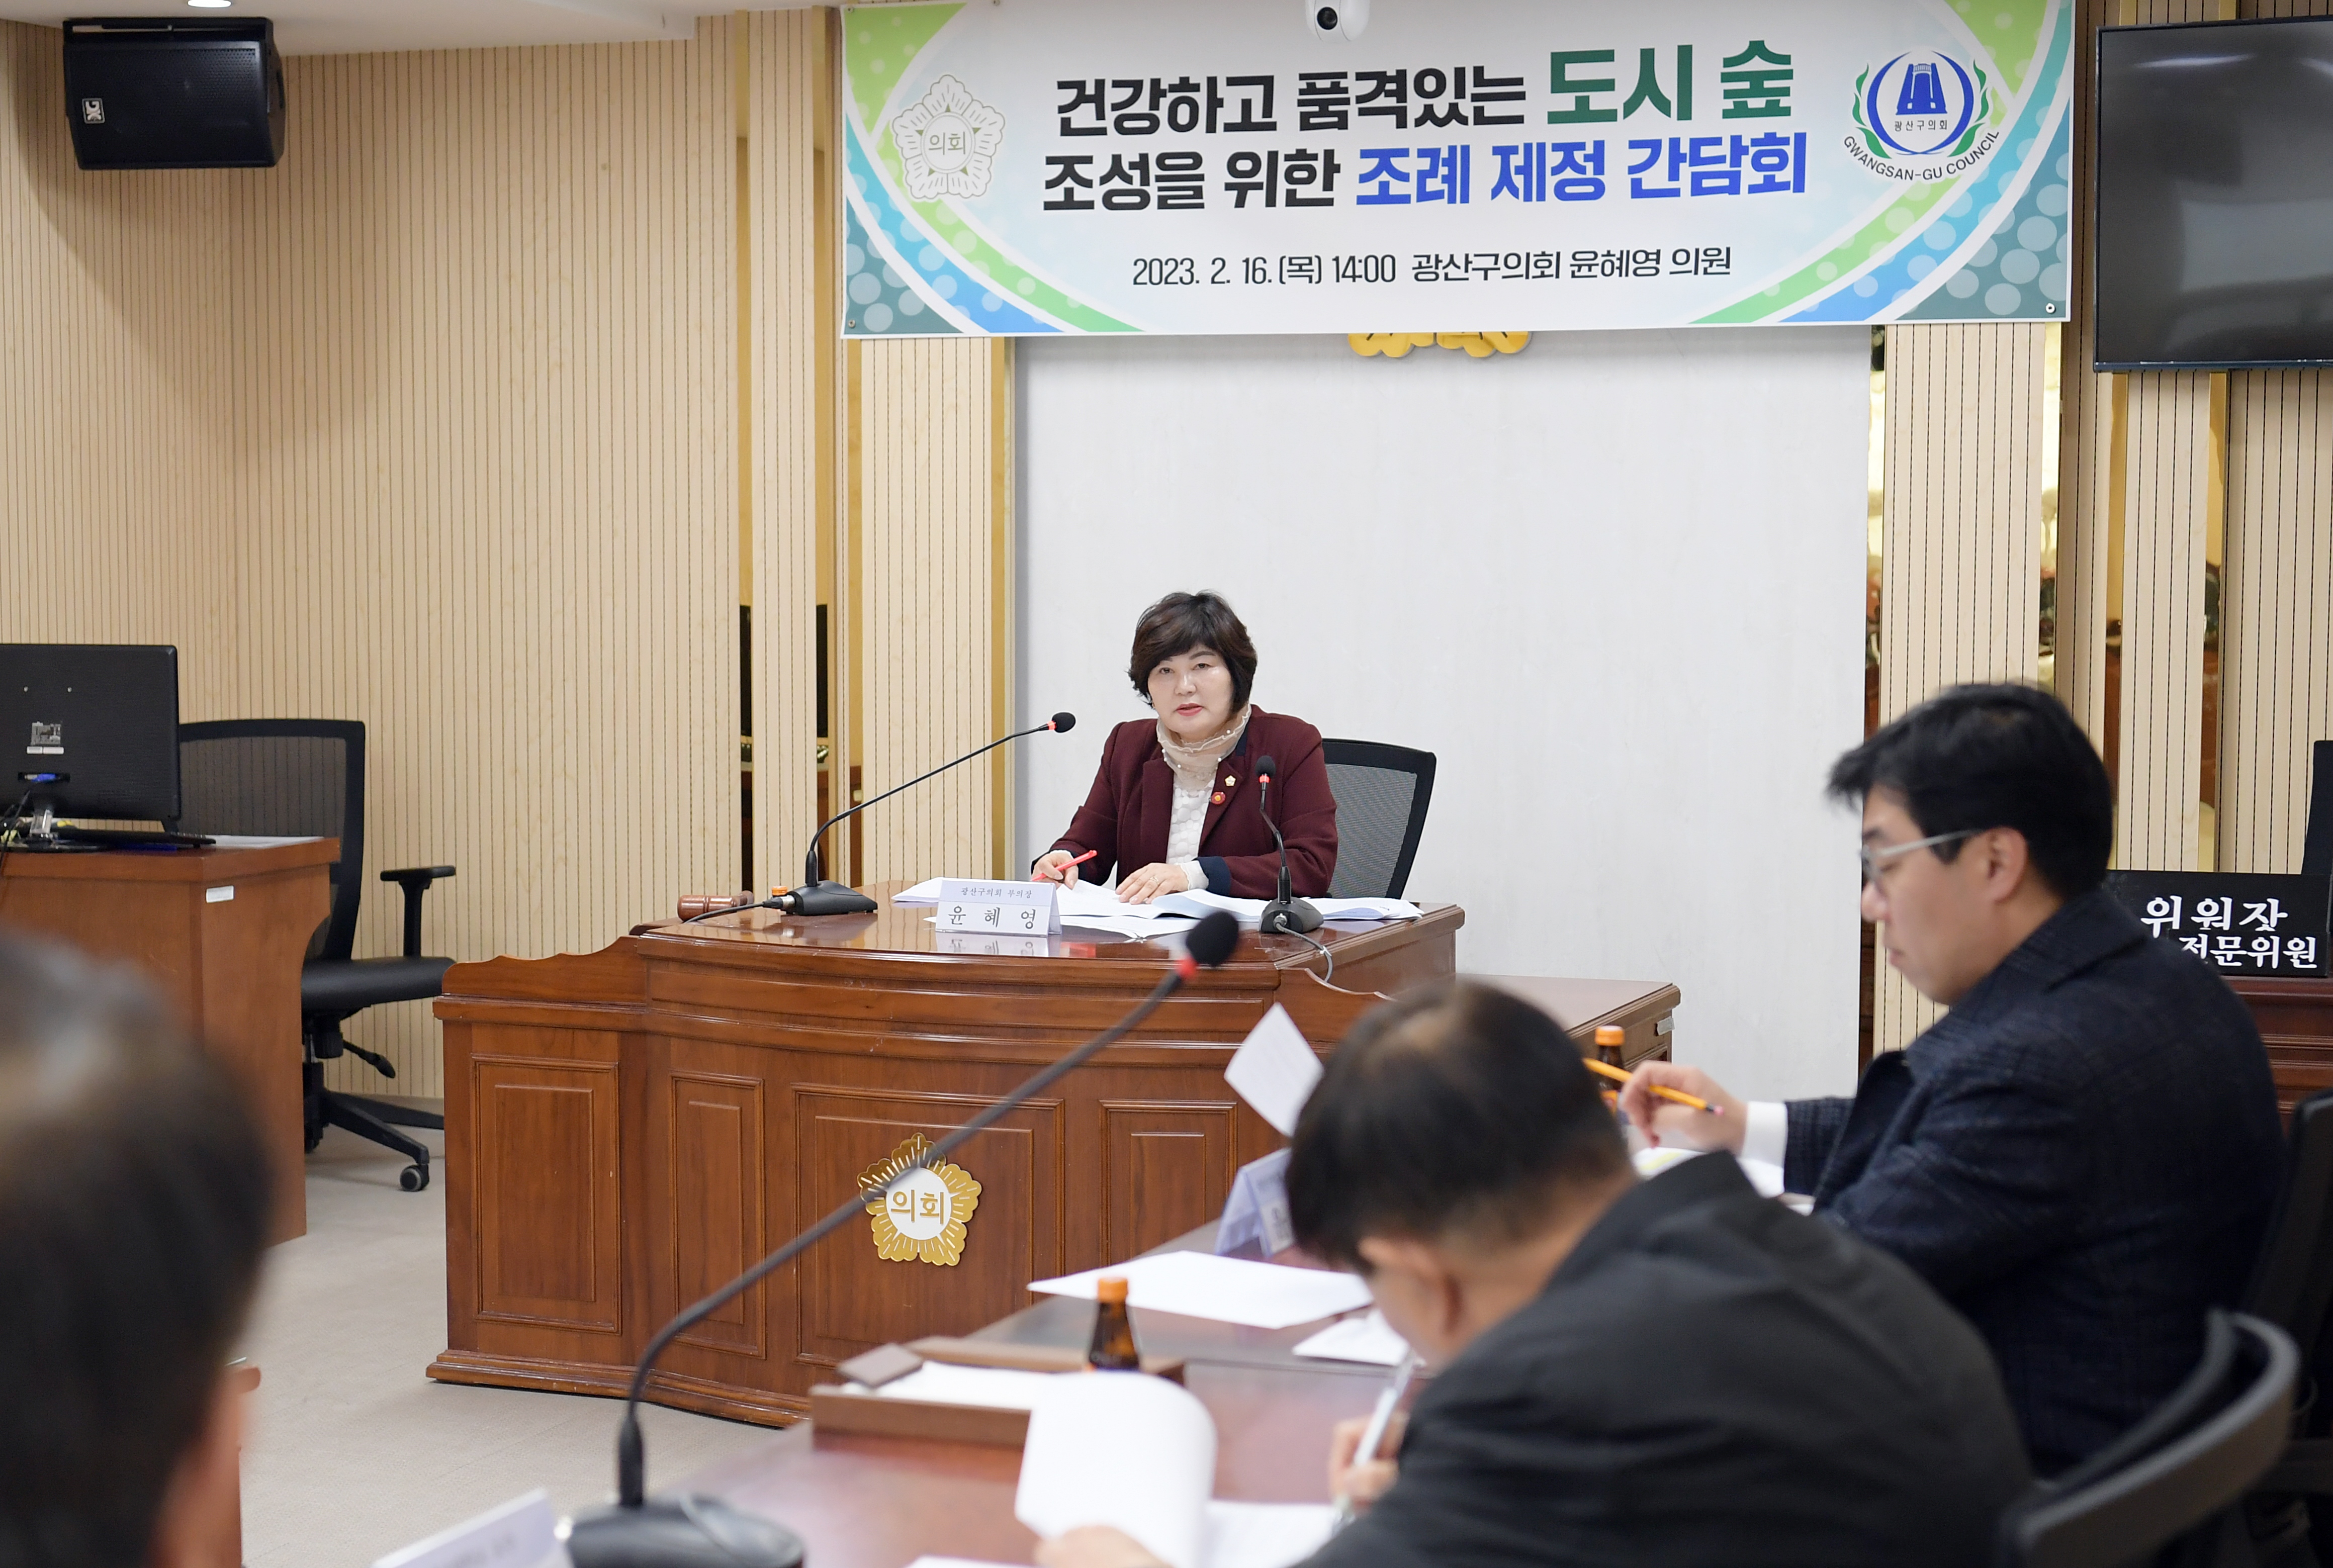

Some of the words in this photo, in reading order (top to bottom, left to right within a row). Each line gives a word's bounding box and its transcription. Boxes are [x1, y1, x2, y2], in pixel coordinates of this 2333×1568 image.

[1057, 75, 1277, 136] 건강하고
[1297, 65, 1526, 131] 품격있는
[1547, 44, 1693, 124] 도시
[1720, 40, 1793, 119] 숲
[928, 131, 966, 155] 의회
[1844, 136, 1942, 181] GWANGSAN-GU
[1946, 130, 2000, 175] COUNCIL
[1043, 151, 1205, 211] 조성을
[1224, 148, 1341, 208] 위한
[1356, 144, 1470, 205] 조례
[1491, 140, 1605, 202] 제정
[1628, 132, 1807, 199] 간담회
[1133, 258, 1200, 286] 2023.
[1211, 257, 1230, 284] 2.
[1332, 254, 1396, 283] 14:00
[1412, 251, 1561, 282] 광산구의회
[1570, 249, 1661, 279] 윤혜영
[1669, 247, 1731, 275] 의원
[961, 887, 1002, 897] 광산구의회
[1008, 889, 1032, 899] 부의장
[890, 1189, 944, 1225] 의회
